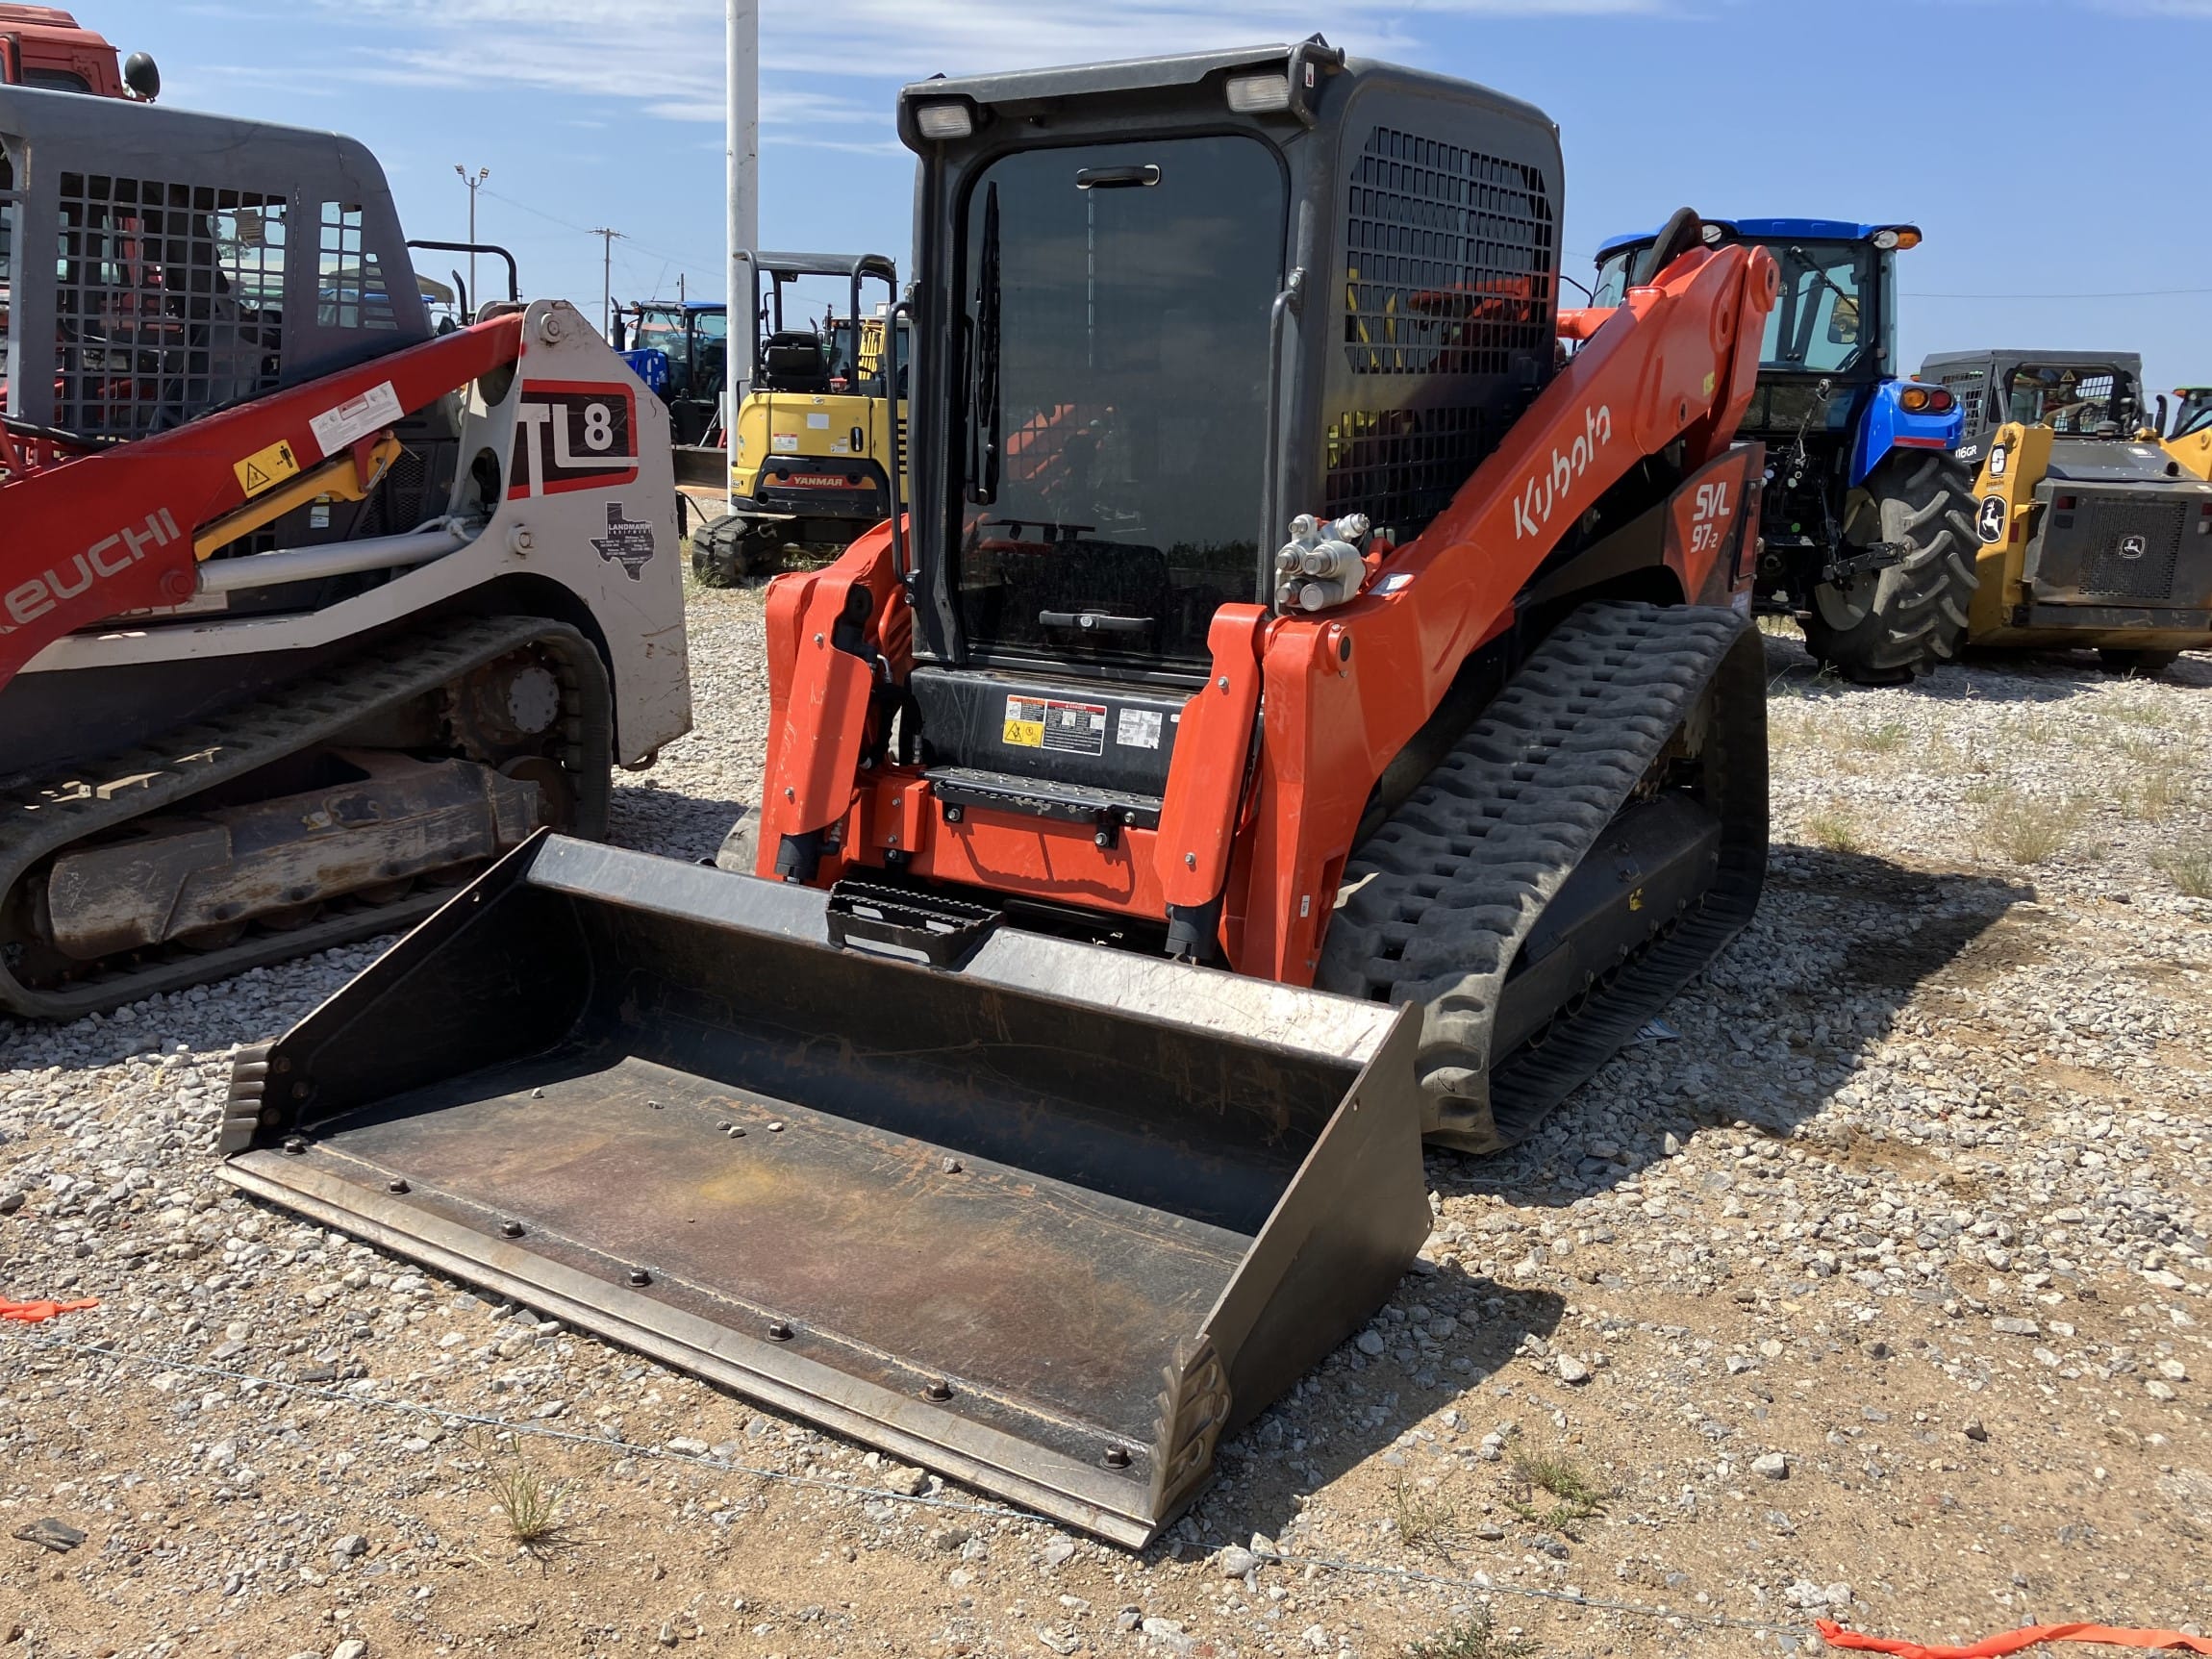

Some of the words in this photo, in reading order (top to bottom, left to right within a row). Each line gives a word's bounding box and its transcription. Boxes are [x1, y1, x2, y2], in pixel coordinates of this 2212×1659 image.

[515, 402, 639, 496] TL8
[793, 476, 843, 487] YANMAR
[1513, 404, 1612, 540] Kubota
[1693, 482, 1730, 520] SVL
[1690, 523, 1719, 553] 97-2
